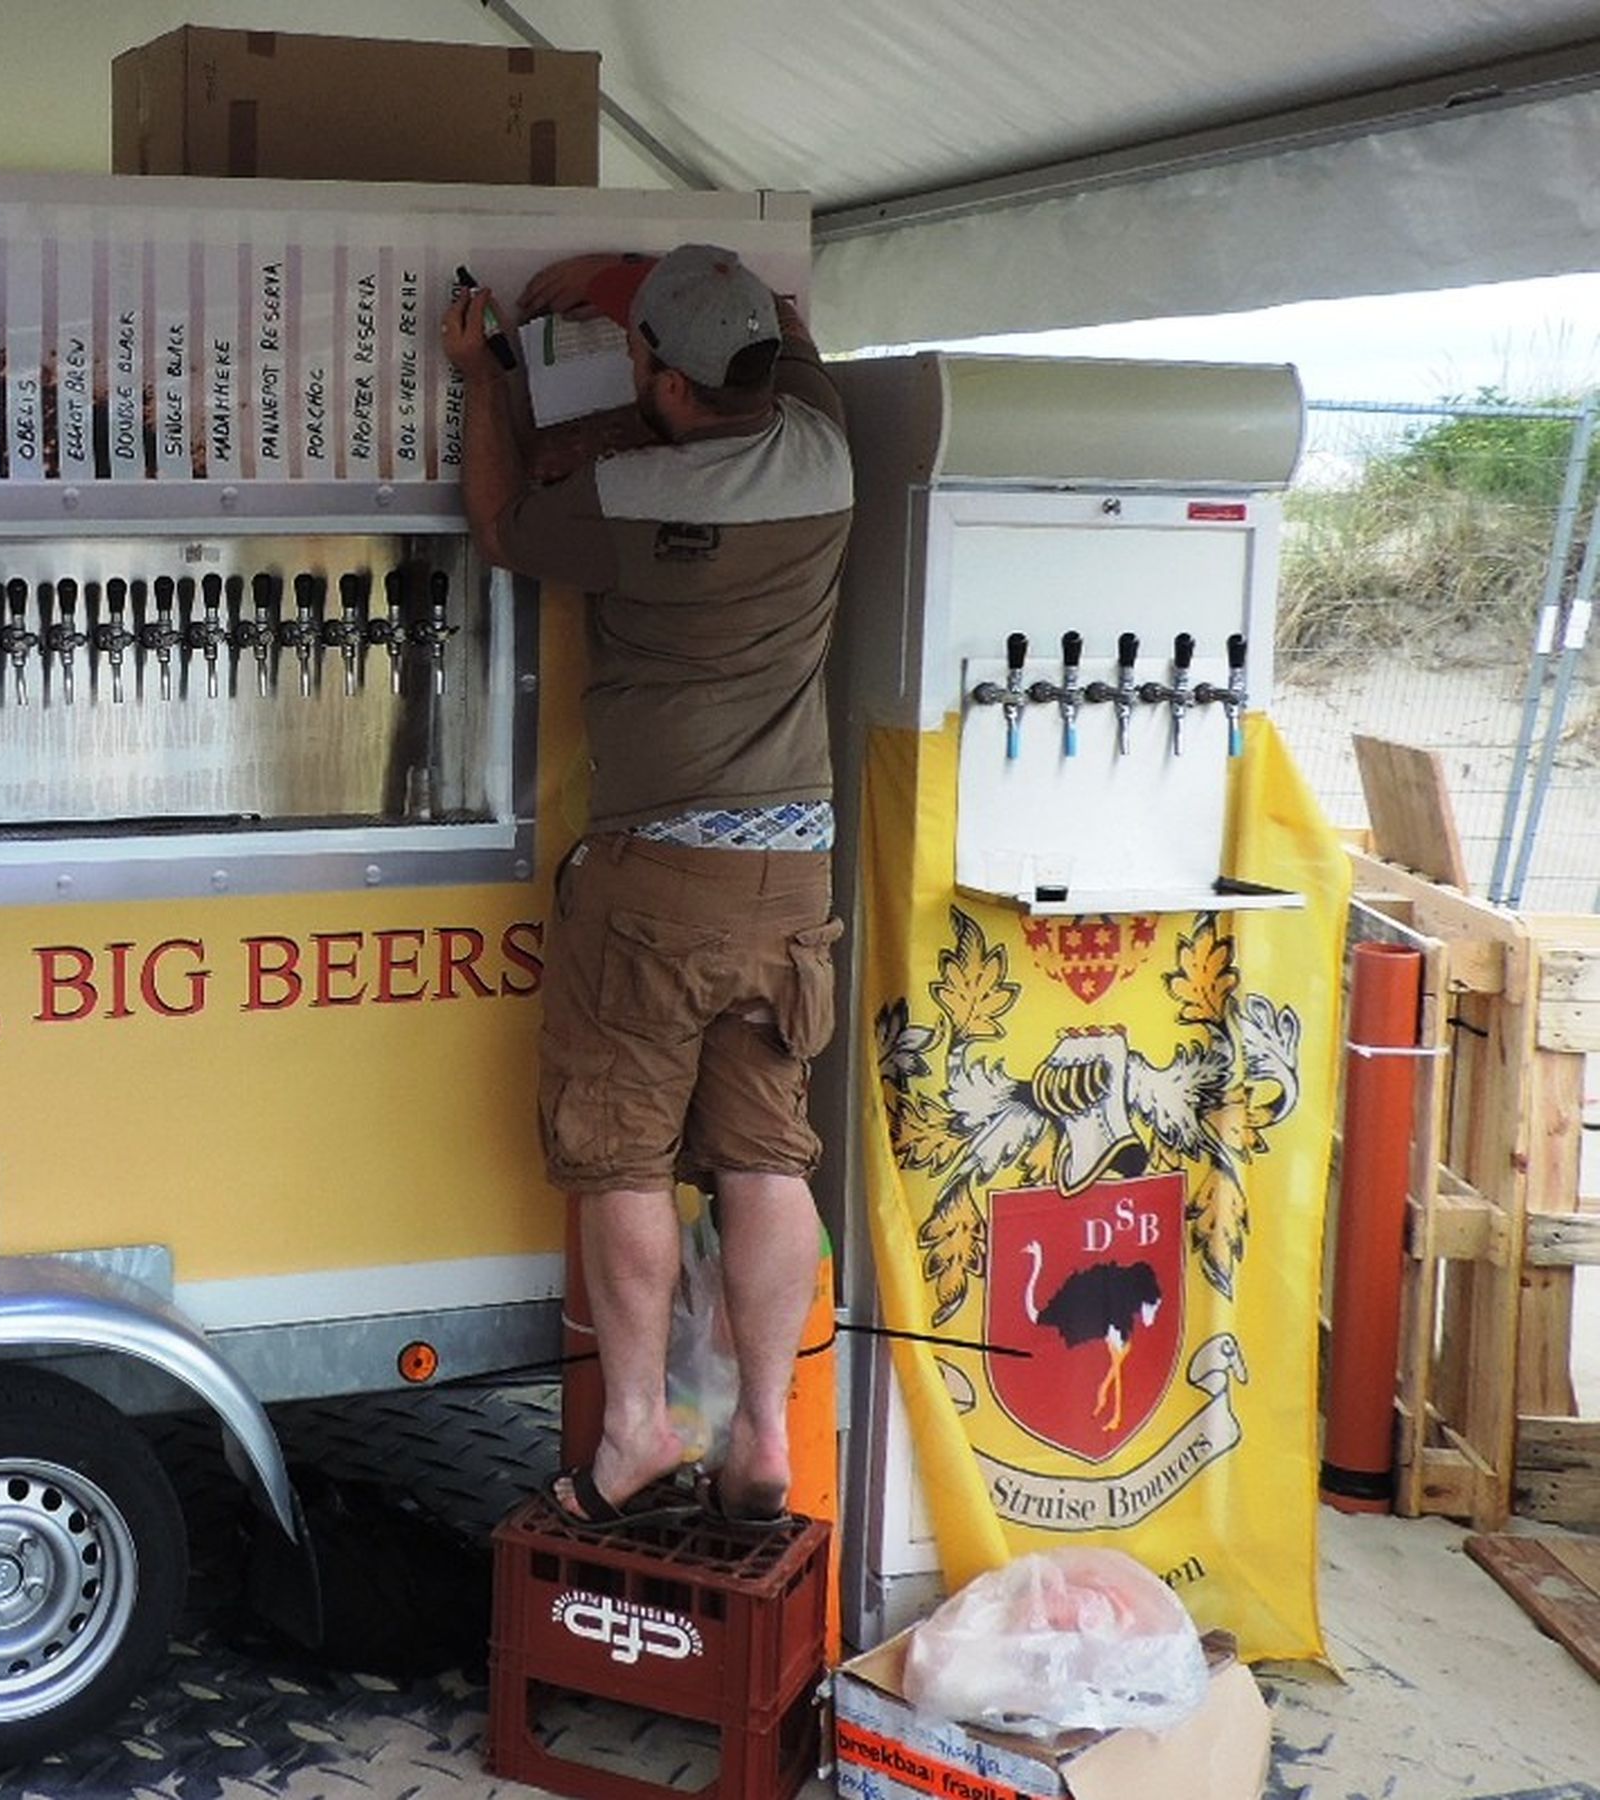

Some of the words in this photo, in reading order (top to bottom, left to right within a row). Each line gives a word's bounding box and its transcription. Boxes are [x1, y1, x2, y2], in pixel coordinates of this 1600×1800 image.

[118, 309, 136, 374] BLACK
[167, 323, 185, 378] BLACK
[353, 273, 376, 365] RESERVA
[63, 337, 85, 392] BREW
[32, 938, 213, 1023] BIG
[240, 920, 545, 1014] BEERS
[990, 1475, 1097, 1522] Struise
[1106, 1432, 1215, 1519] Brouwers
